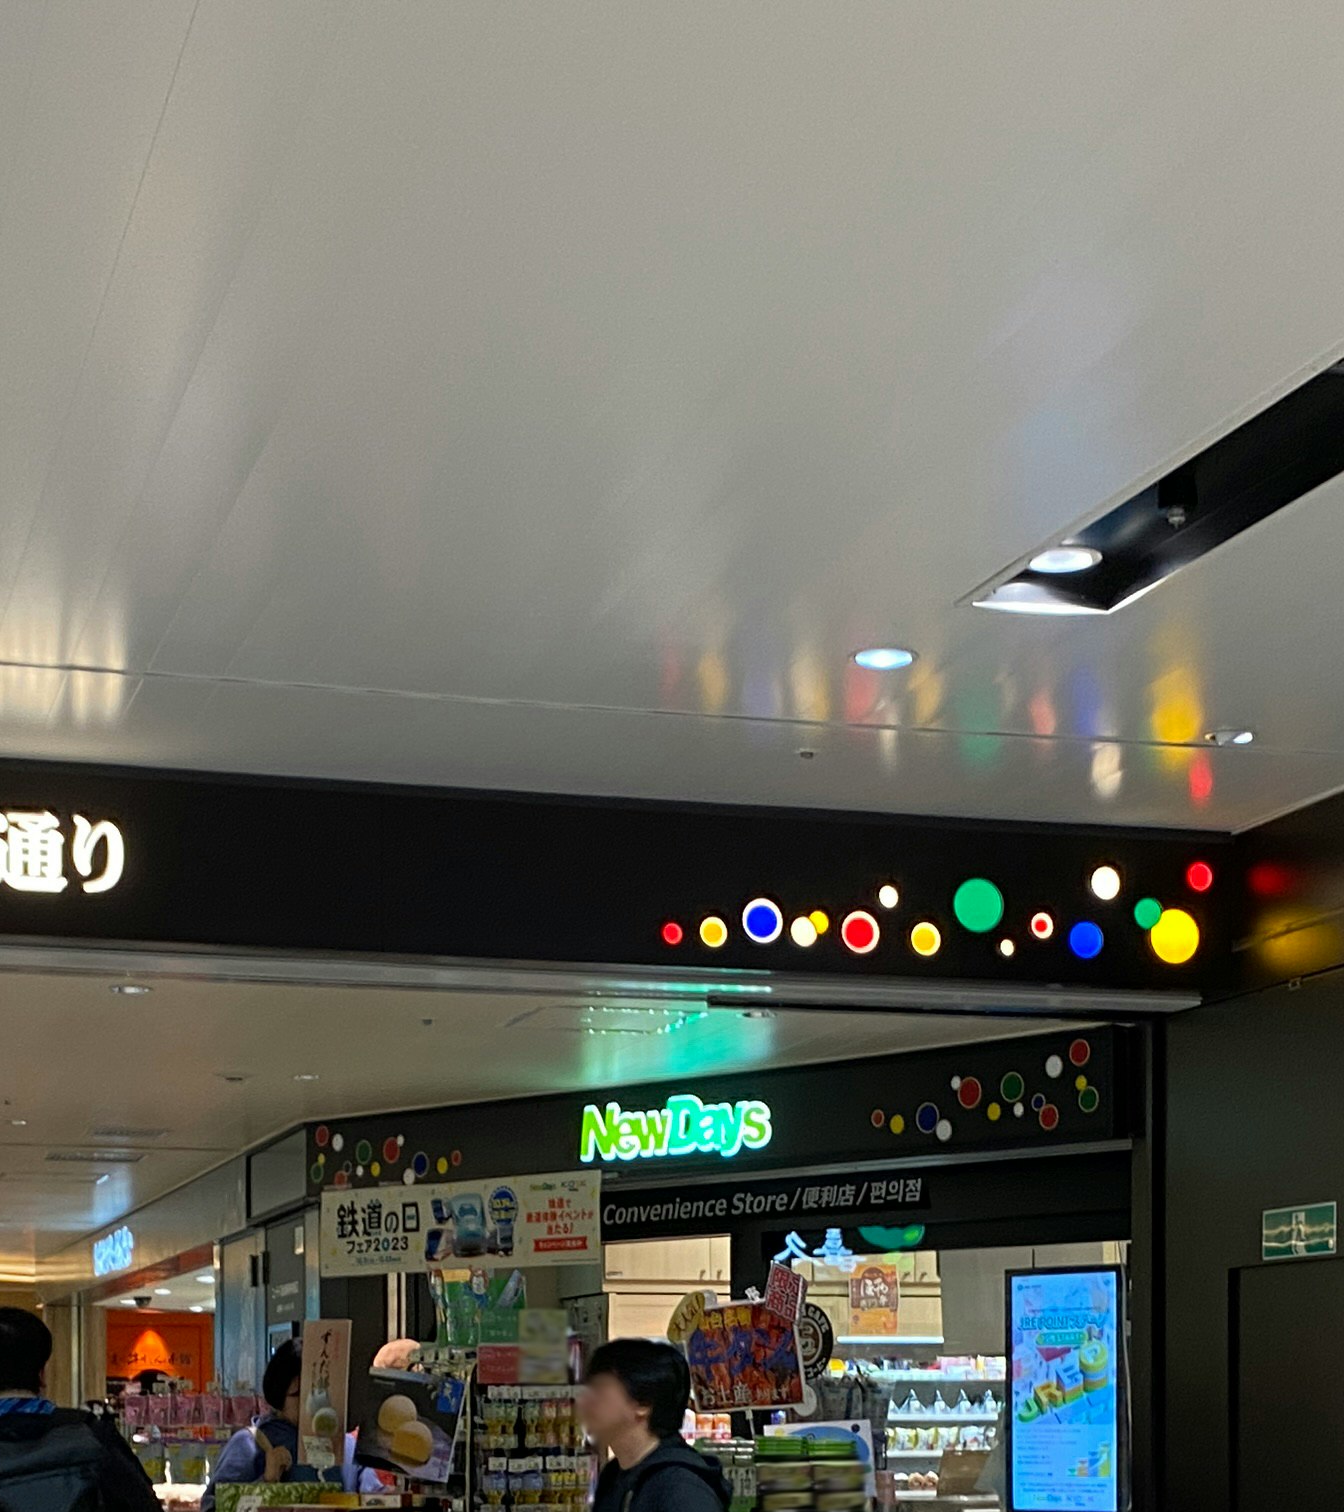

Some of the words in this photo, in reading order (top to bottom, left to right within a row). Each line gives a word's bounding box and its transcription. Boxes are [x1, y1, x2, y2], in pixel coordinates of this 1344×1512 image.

[580, 1095, 772, 1163] NewDays
[337, 1199, 420, 1238] 鉄道の日
[604, 1197, 727, 1225] Convenience
[731, 1193, 788, 1215] Store
[802, 1184, 856, 1209] 便利店
[870, 1178, 922, 1204] 편의점
[346, 1236, 409, 1254] フェア2023
